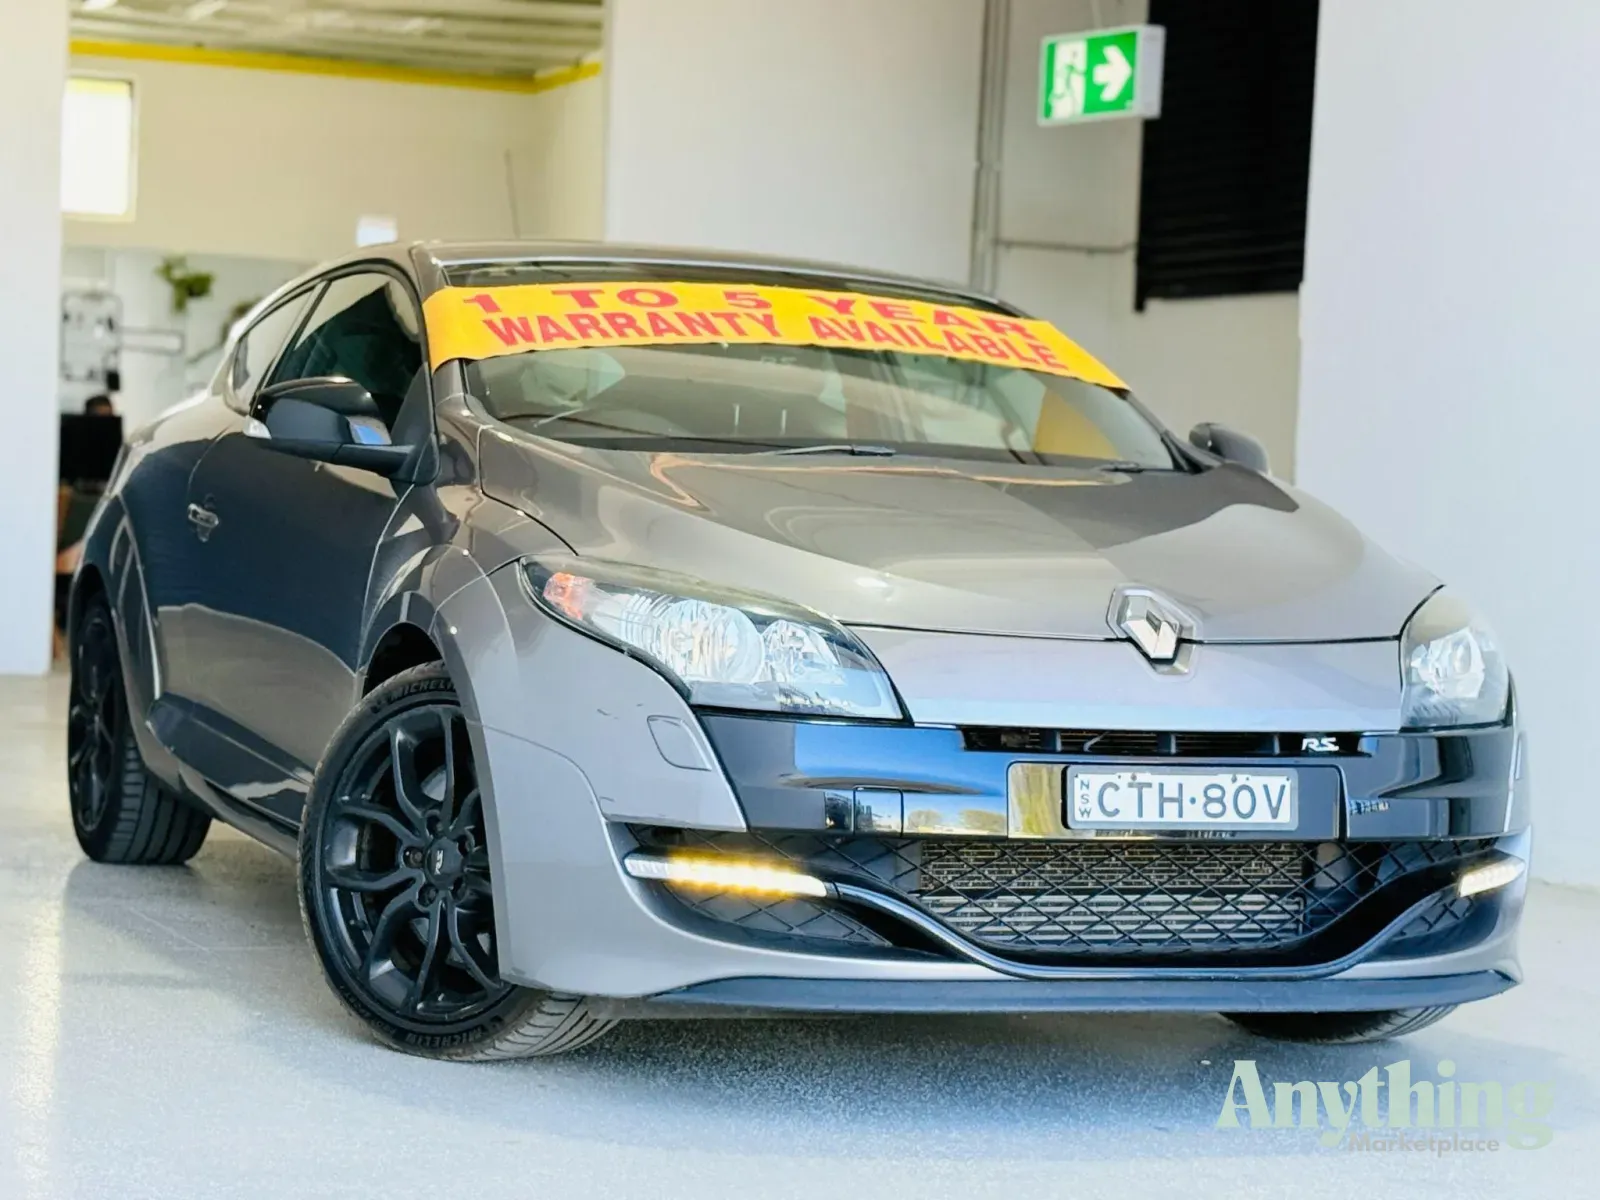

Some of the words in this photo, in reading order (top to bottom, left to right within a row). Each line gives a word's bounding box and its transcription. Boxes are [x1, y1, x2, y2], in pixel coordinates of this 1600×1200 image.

[463, 293, 502, 313] 1
[551, 288, 679, 310] TO
[723, 291, 773, 310] 5
[806, 296, 1042, 341] YEAR
[482, 311, 783, 347] WARRANTY
[808, 316, 1069, 370] AVAILABLE
[405, 1024, 483, 1049] MICHELIN
